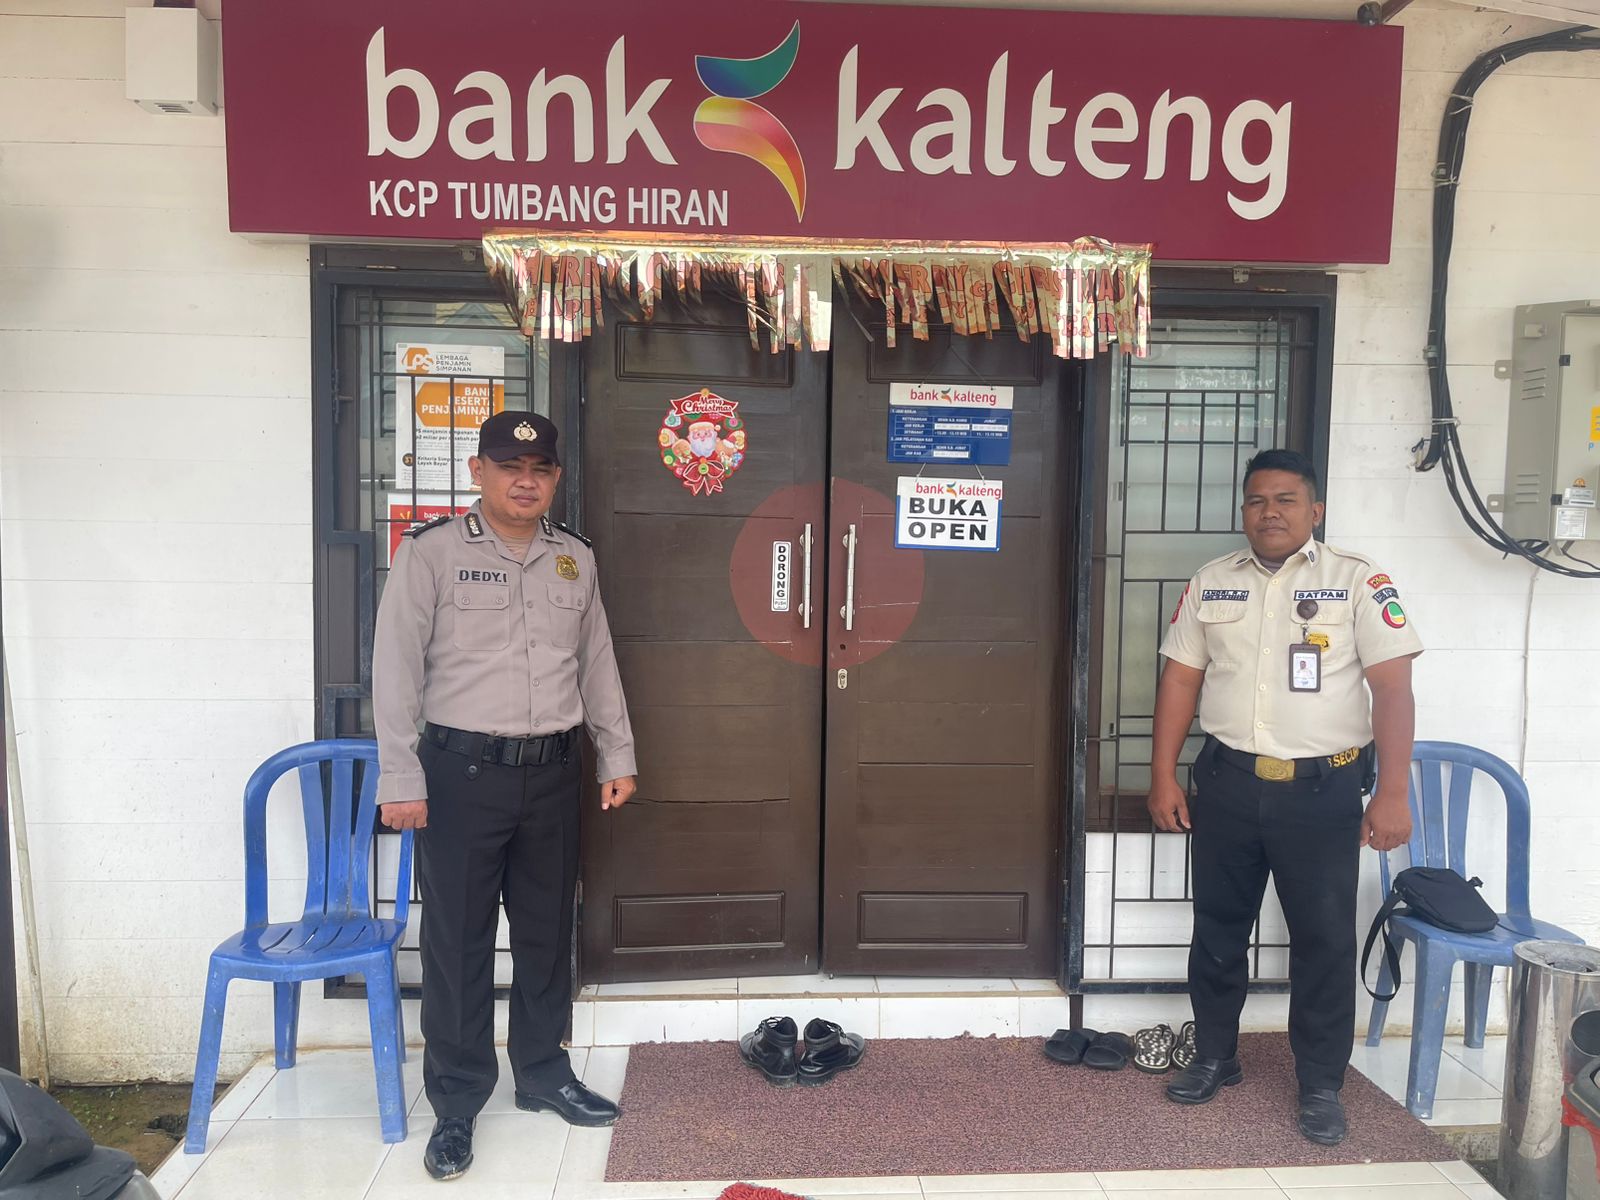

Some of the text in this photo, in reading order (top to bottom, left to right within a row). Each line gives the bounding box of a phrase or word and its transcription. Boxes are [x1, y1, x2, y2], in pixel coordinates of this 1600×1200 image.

[366, 26, 1292, 220] bank kalteng
[369, 179, 728, 227] KCP TUMBANG HIRAN
[465, 387, 493, 397] BAN
[910, 388, 997, 406] bank kalteng
[682, 400, 733, 413] Christmas
[475, 416, 488, 425] LP
[916, 482, 1002, 500] bank kalteng
[909, 497, 987, 517] BUKA
[908, 521, 987, 541] OPEN
[776, 545, 787, 598] DORONG
[1297, 591, 1346, 600] SATPAM
